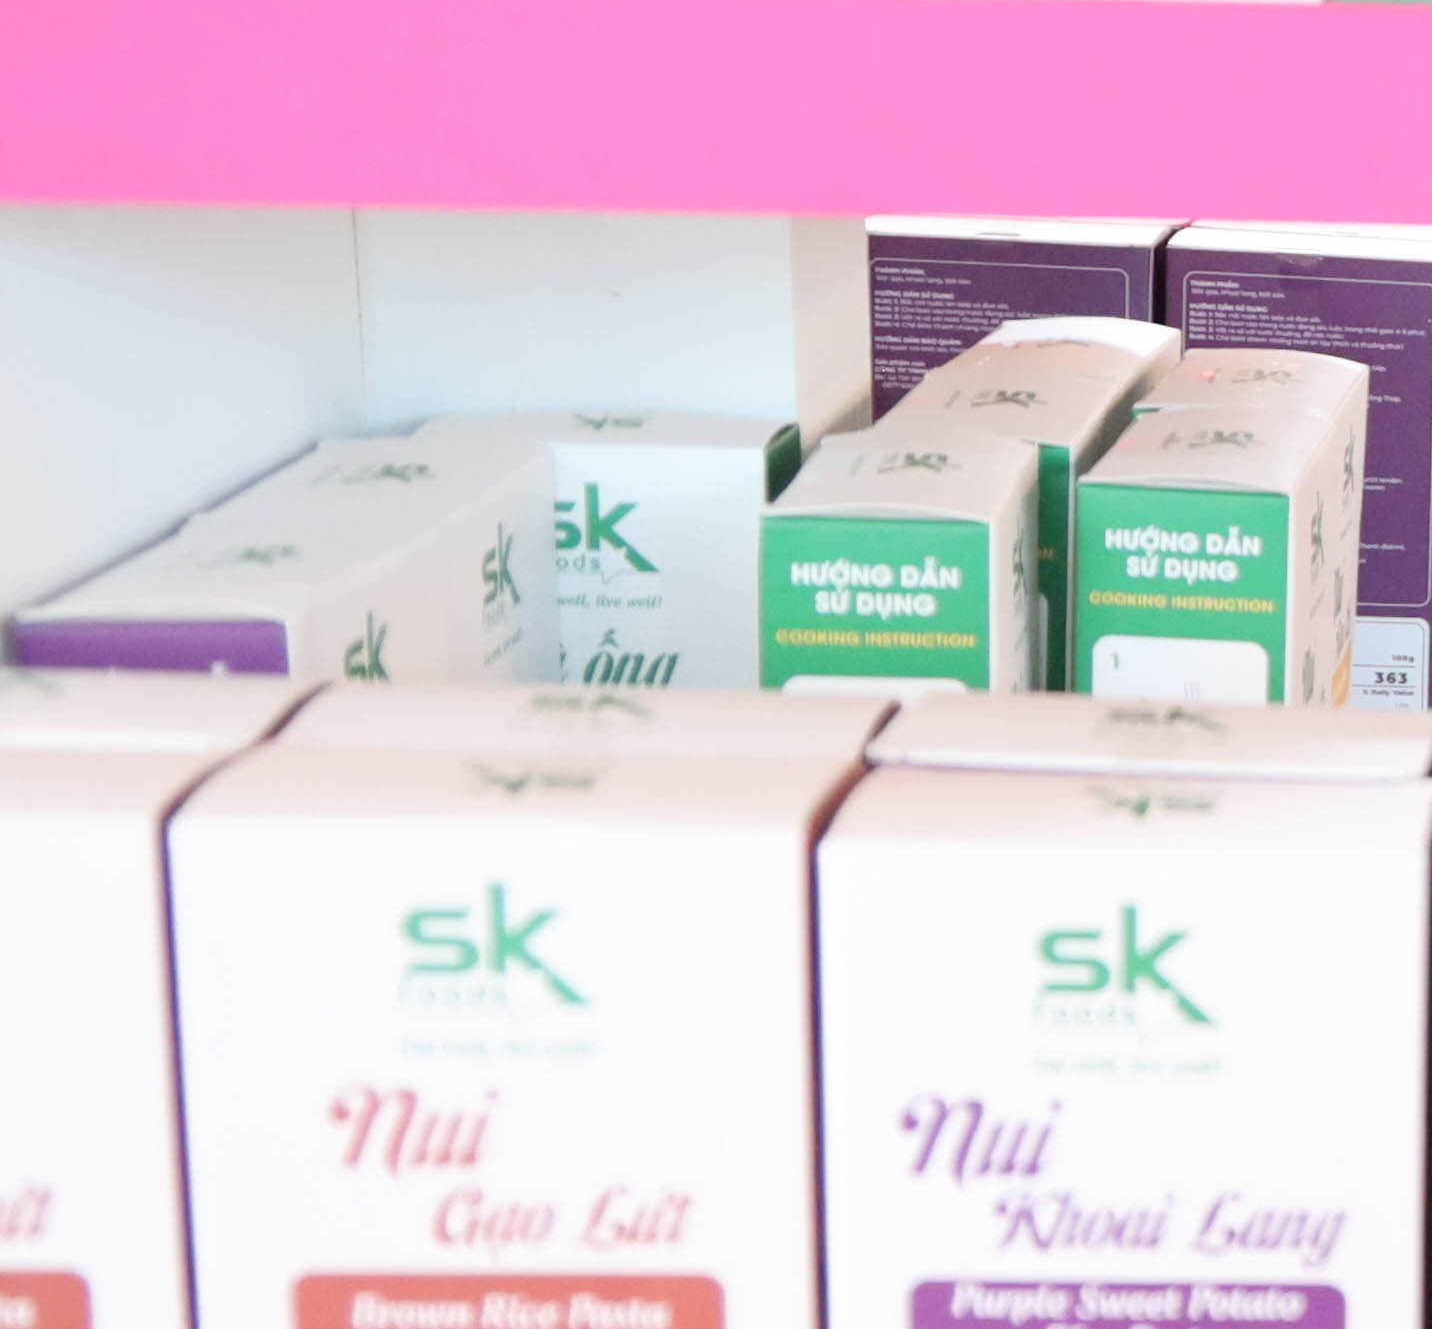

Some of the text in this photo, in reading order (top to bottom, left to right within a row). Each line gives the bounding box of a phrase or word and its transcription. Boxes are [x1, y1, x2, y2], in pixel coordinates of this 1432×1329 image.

[1104, 525, 1262, 556] HƯỚNG DẪN
[790, 555, 961, 589] HƯỚNG DẪN
[1164, 559, 1239, 585] DỤNG
[855, 591, 937, 620] DỤNG
[1089, 590, 1275, 613] COOKING INSTRUCTION
[776, 628, 976, 648] COOKING INSTRUCTION
[1375, 672, 1408, 684] 363
[328, 1087, 499, 1175] Nui
[899, 1097, 1064, 1185] Nui
[951, 1283, 1307, 1326] Purple Sweet Potato
